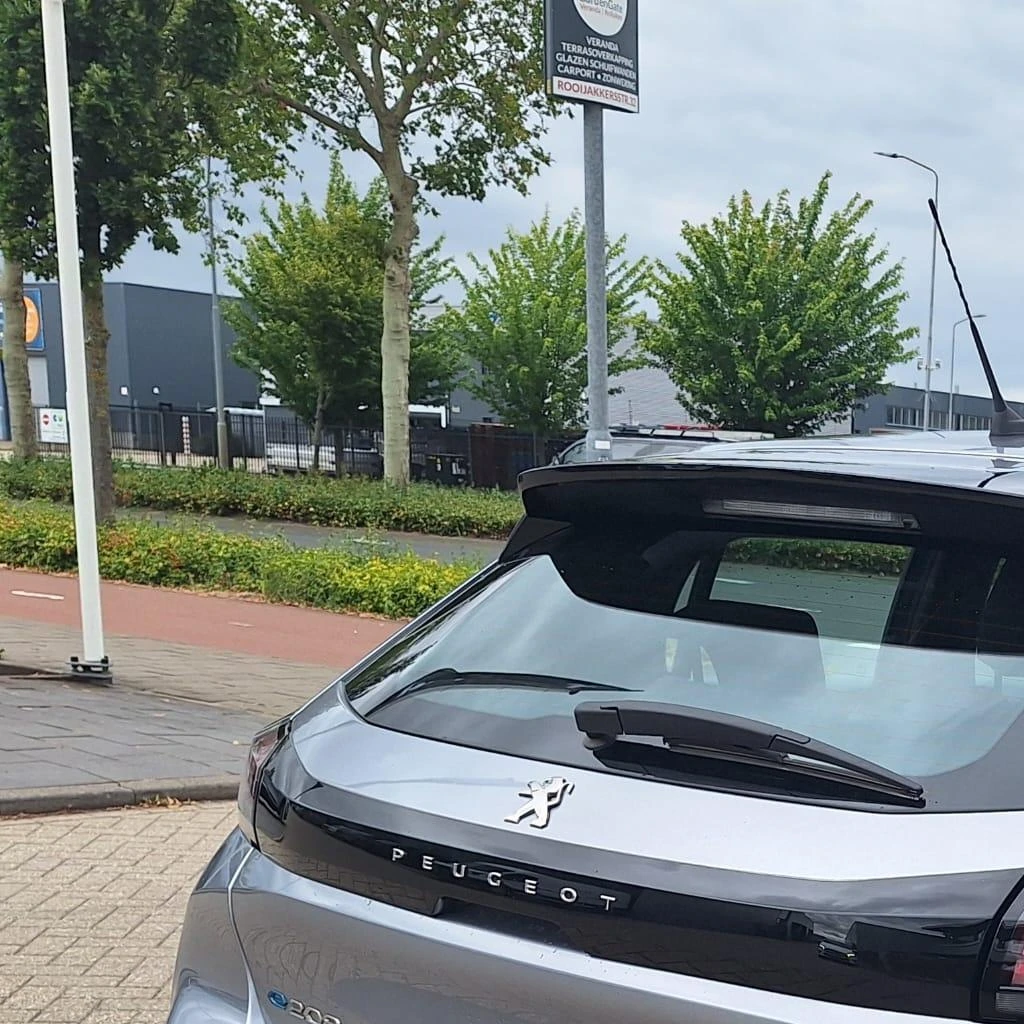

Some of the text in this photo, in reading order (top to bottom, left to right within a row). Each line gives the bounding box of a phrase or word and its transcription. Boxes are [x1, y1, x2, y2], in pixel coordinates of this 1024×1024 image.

[586, 36, 619, 52] VERANDA
[556, 52, 589, 66] GLAZEN
[561, 41, 634, 69] TERRASOVERKAPPING
[557, 64, 596, 80] CARPORT
[391, 847, 616, 911] PEUGEOT
